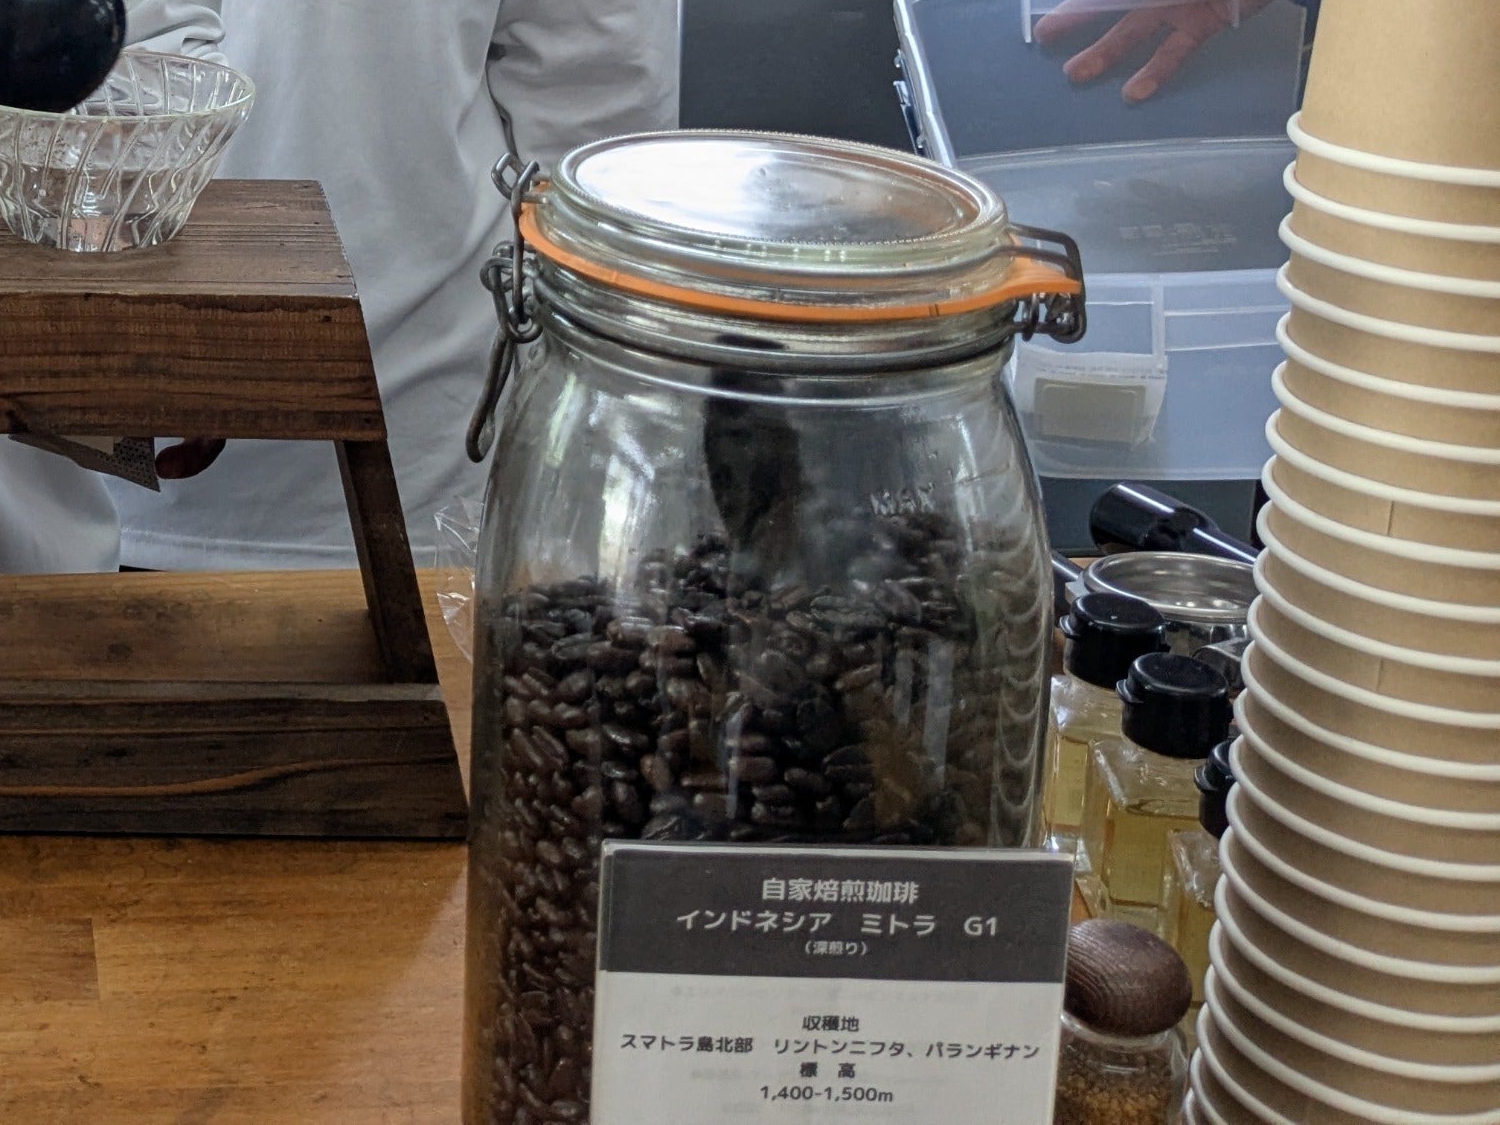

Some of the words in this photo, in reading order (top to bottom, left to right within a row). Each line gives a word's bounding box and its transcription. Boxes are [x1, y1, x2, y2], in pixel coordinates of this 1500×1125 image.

[761, 877, 920, 904] 自家焙煎珈琲
[676, 909, 833, 932] インドネシア
[860, 913, 937, 936] ミトラ
[963, 916, 999, 937] G1
[802, 1015, 860, 1032] 収穫地
[620, 1034, 754, 1053] スマトラ島北部
[838, 1063, 856, 1078] 高
[760, 1086, 894, 1102] 1,400-1,500m
